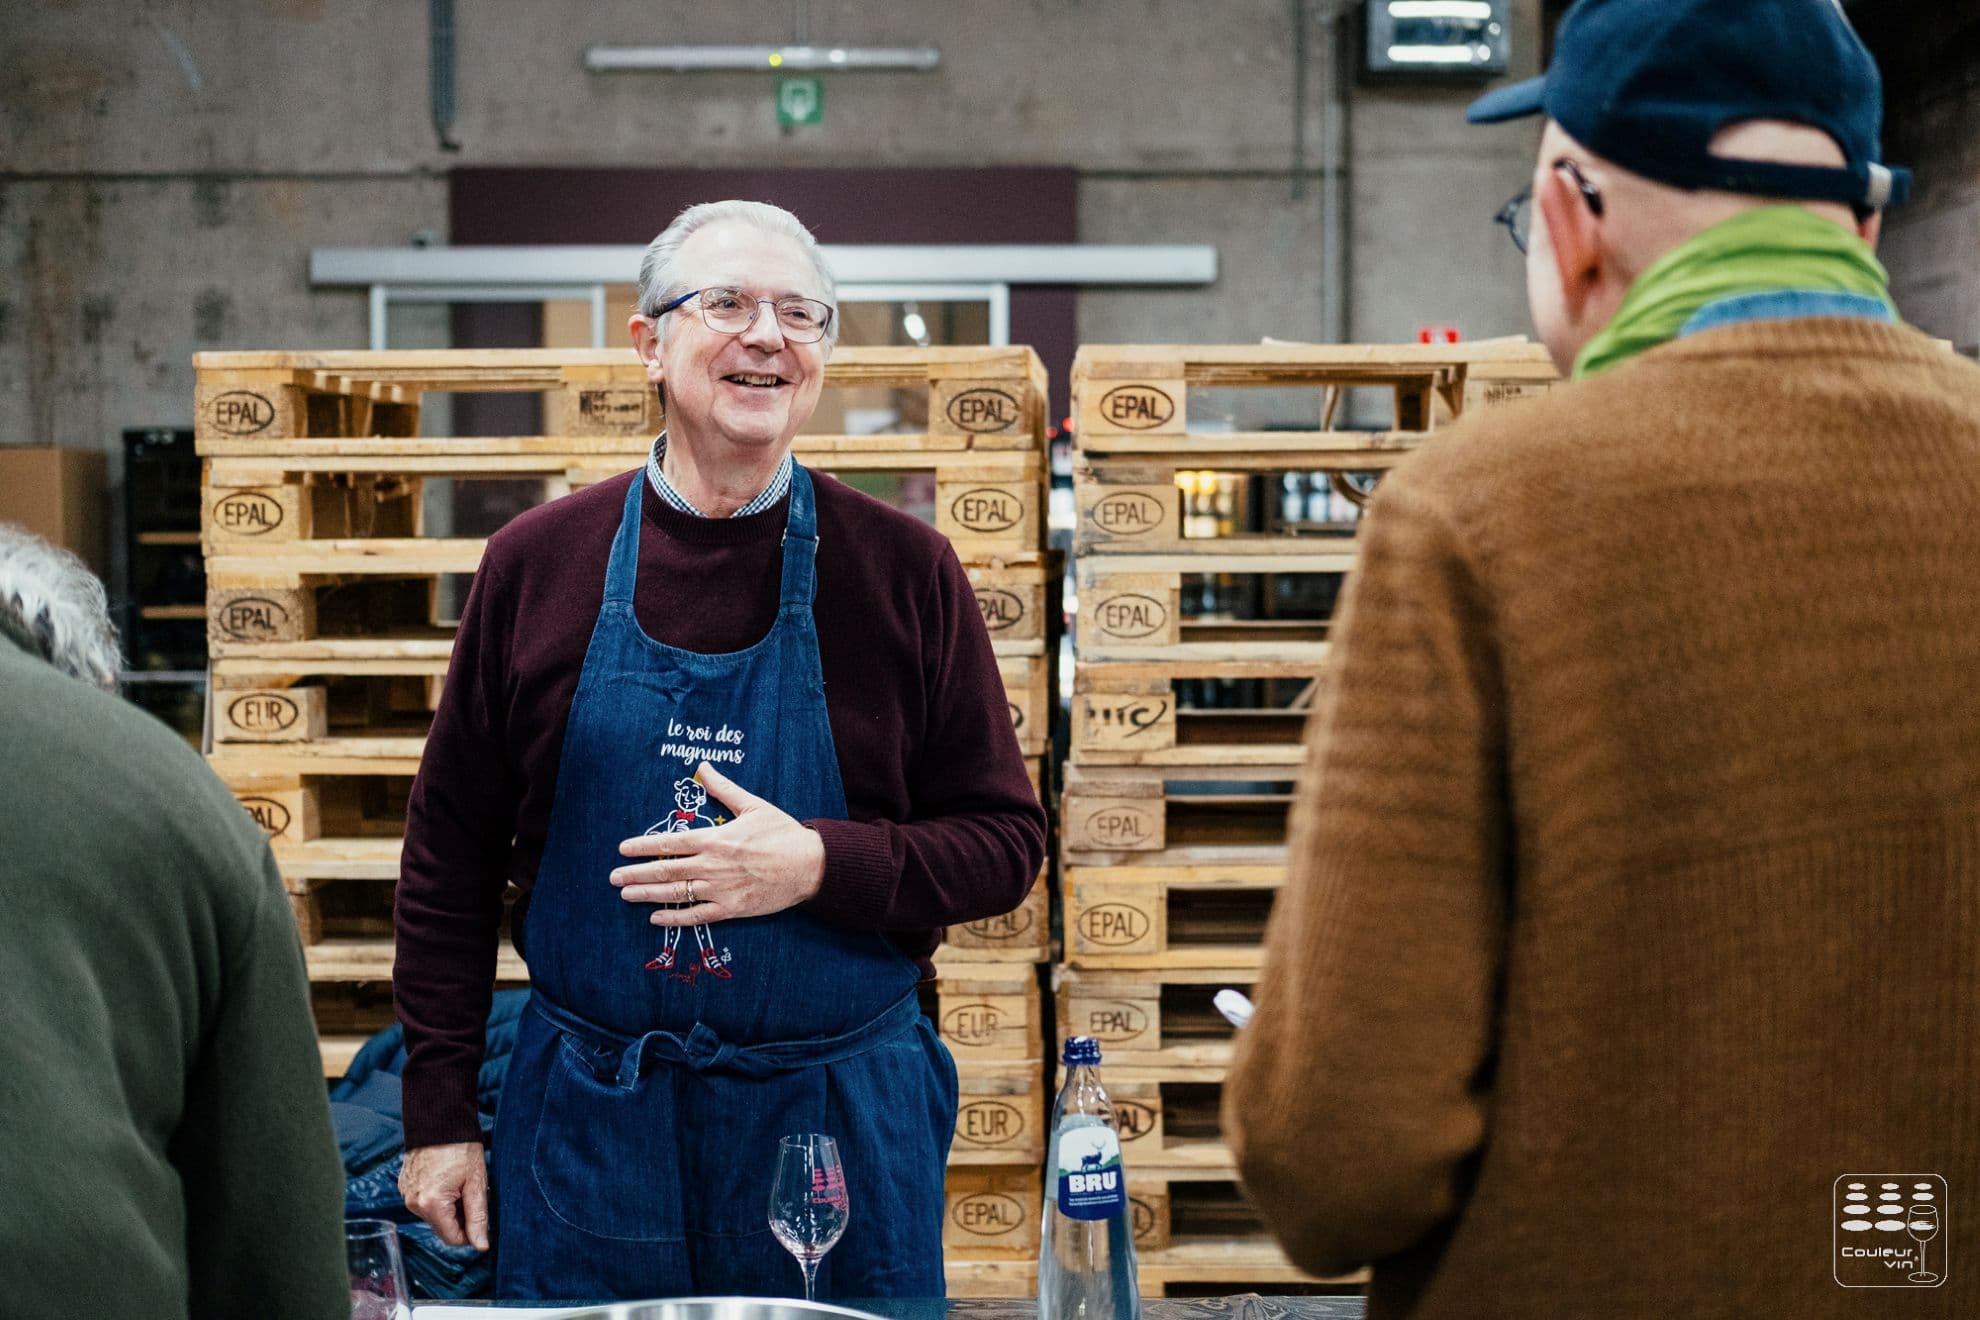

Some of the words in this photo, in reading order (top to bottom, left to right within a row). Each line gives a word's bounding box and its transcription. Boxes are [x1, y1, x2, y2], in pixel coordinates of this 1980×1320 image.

[215, 402, 260, 426] EPAL
[958, 398, 1007, 423] EPAL
[1112, 395, 1163, 419] EPAL
[224, 502, 272, 527] EPAL
[963, 499, 1013, 523] EPAL
[1102, 502, 1153, 526] EPAL
[230, 606, 273, 631] EPAL
[1105, 604, 1156, 627] EPAL
[245, 702, 282, 727] EUR
[668, 718, 684, 736] le
[686, 725, 712, 741] roi
[715, 724, 744, 744] des
[661, 743, 745, 765] magnums
[1097, 816, 1145, 837] EPAL
[1089, 913, 1137, 938] EPAL
[956, 1013, 998, 1038] EUR
[1090, 1012, 1133, 1033] EPAL
[967, 1111, 1007, 1136] EUR
[1069, 1171, 1117, 1193] BRU
[963, 1203, 1013, 1226] EPAL
